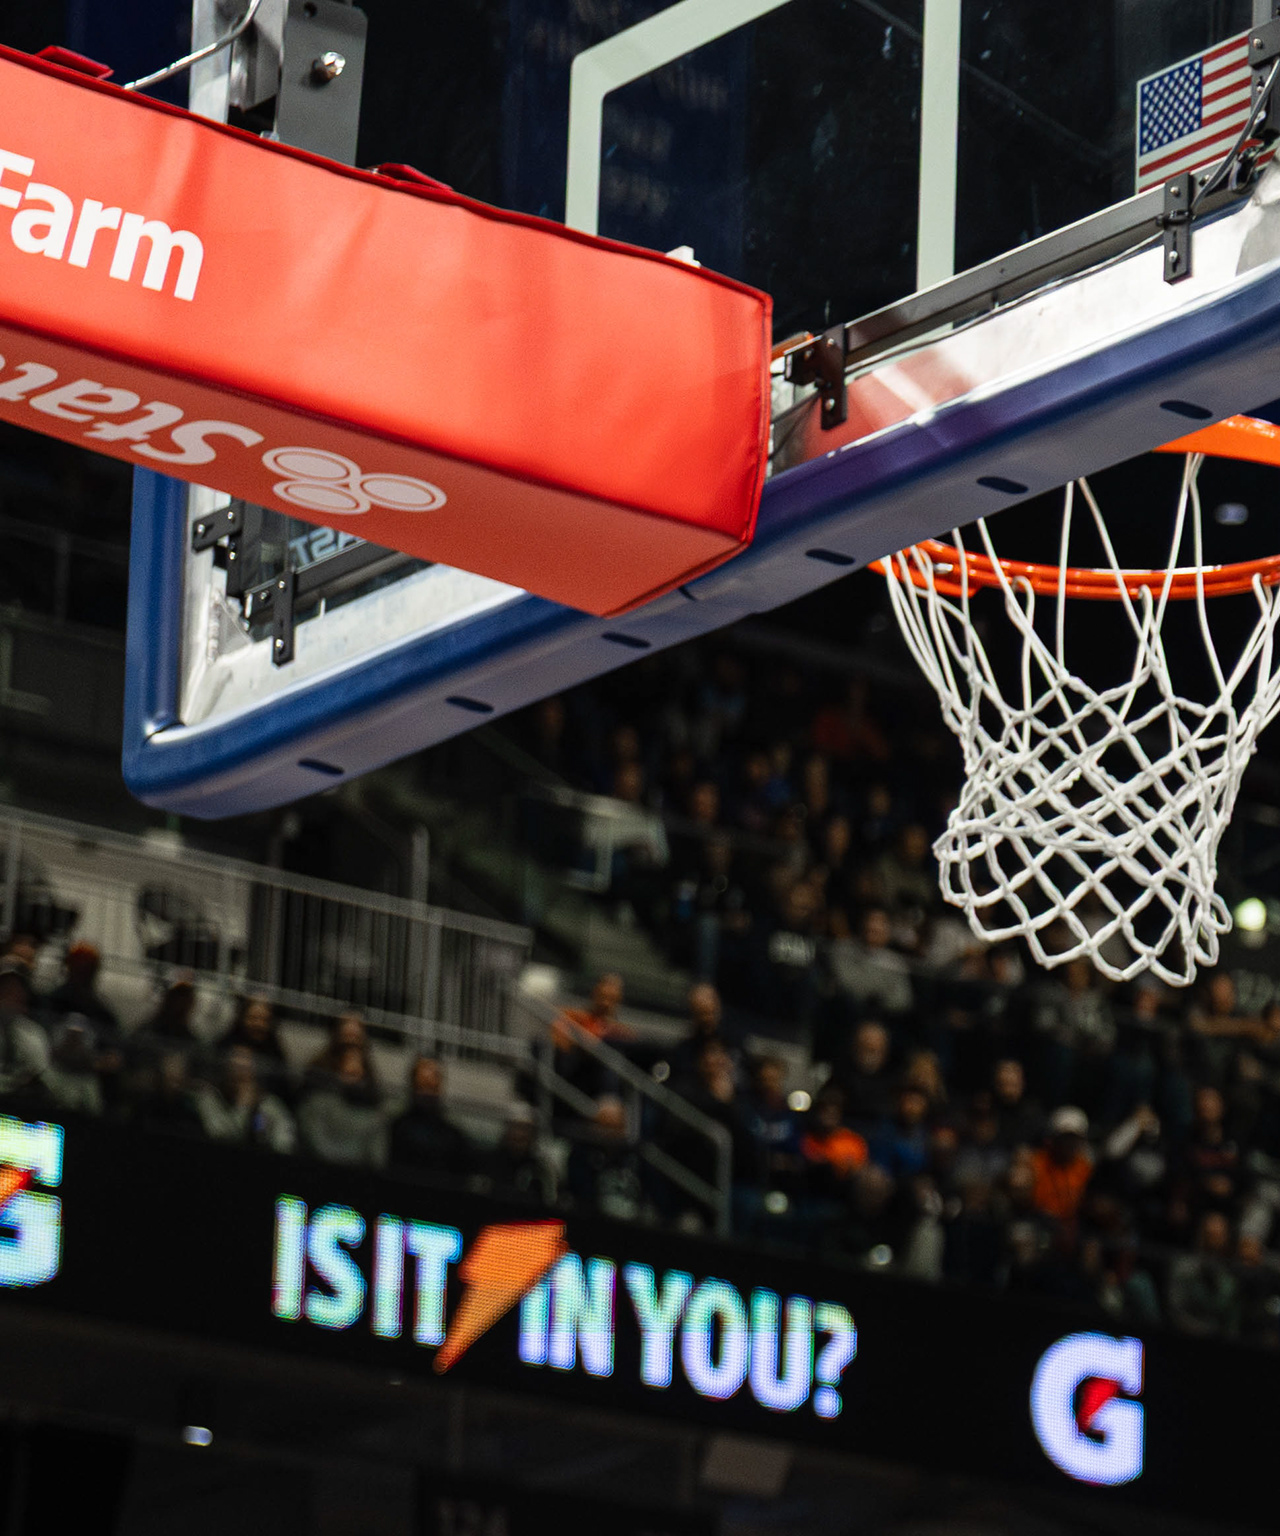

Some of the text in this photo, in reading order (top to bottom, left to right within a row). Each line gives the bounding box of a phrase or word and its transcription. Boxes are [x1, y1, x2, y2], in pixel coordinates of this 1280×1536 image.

[0, 353, 264, 465] Stat
[622, 1259, 859, 1422] YOU?
[1030, 1330, 1145, 1486] G
